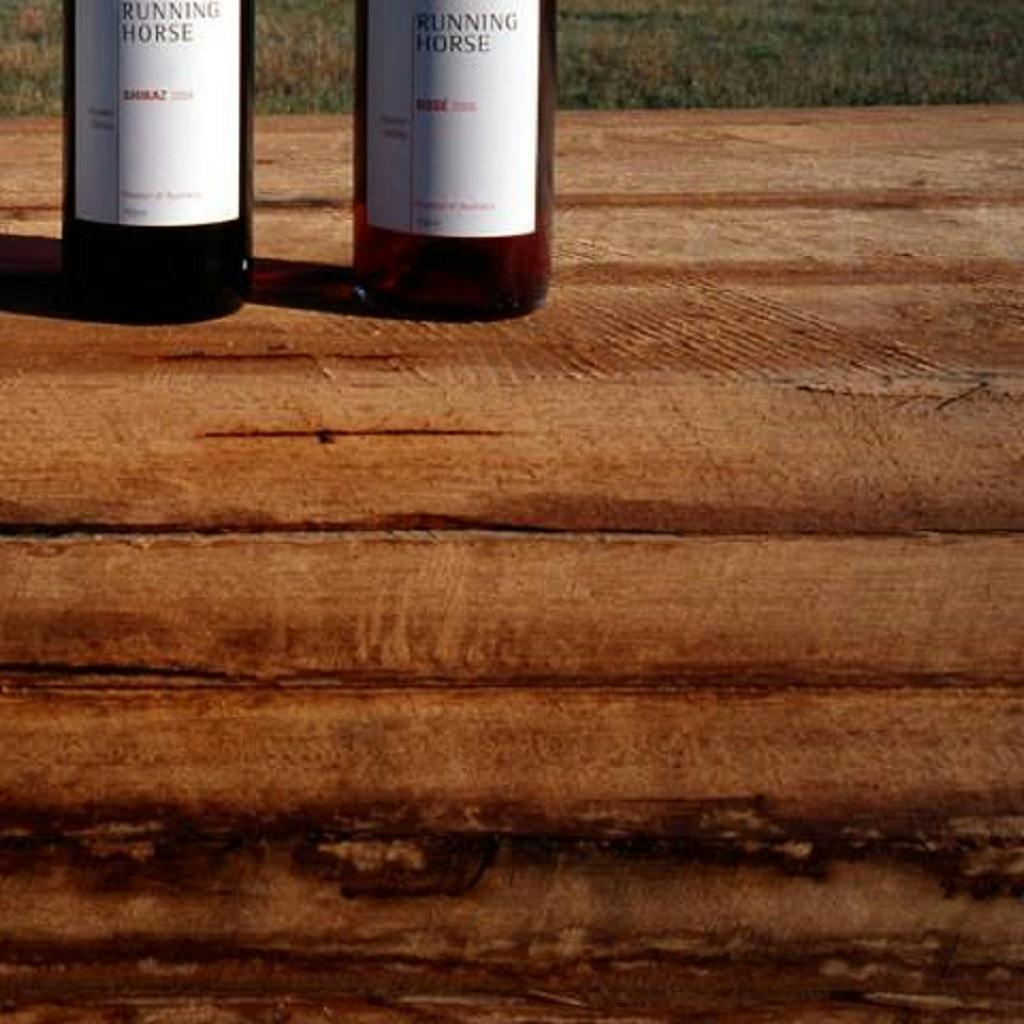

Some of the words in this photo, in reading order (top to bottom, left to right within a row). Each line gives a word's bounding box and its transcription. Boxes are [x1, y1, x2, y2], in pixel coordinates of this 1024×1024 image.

[122, 1, 221, 20] RUNNING
[416, 13, 518, 32] RUNNING
[122, 23, 194, 43] HORSE
[416, 33, 491, 53] HORSE
[122, 89, 167, 101] SHIRAZ
